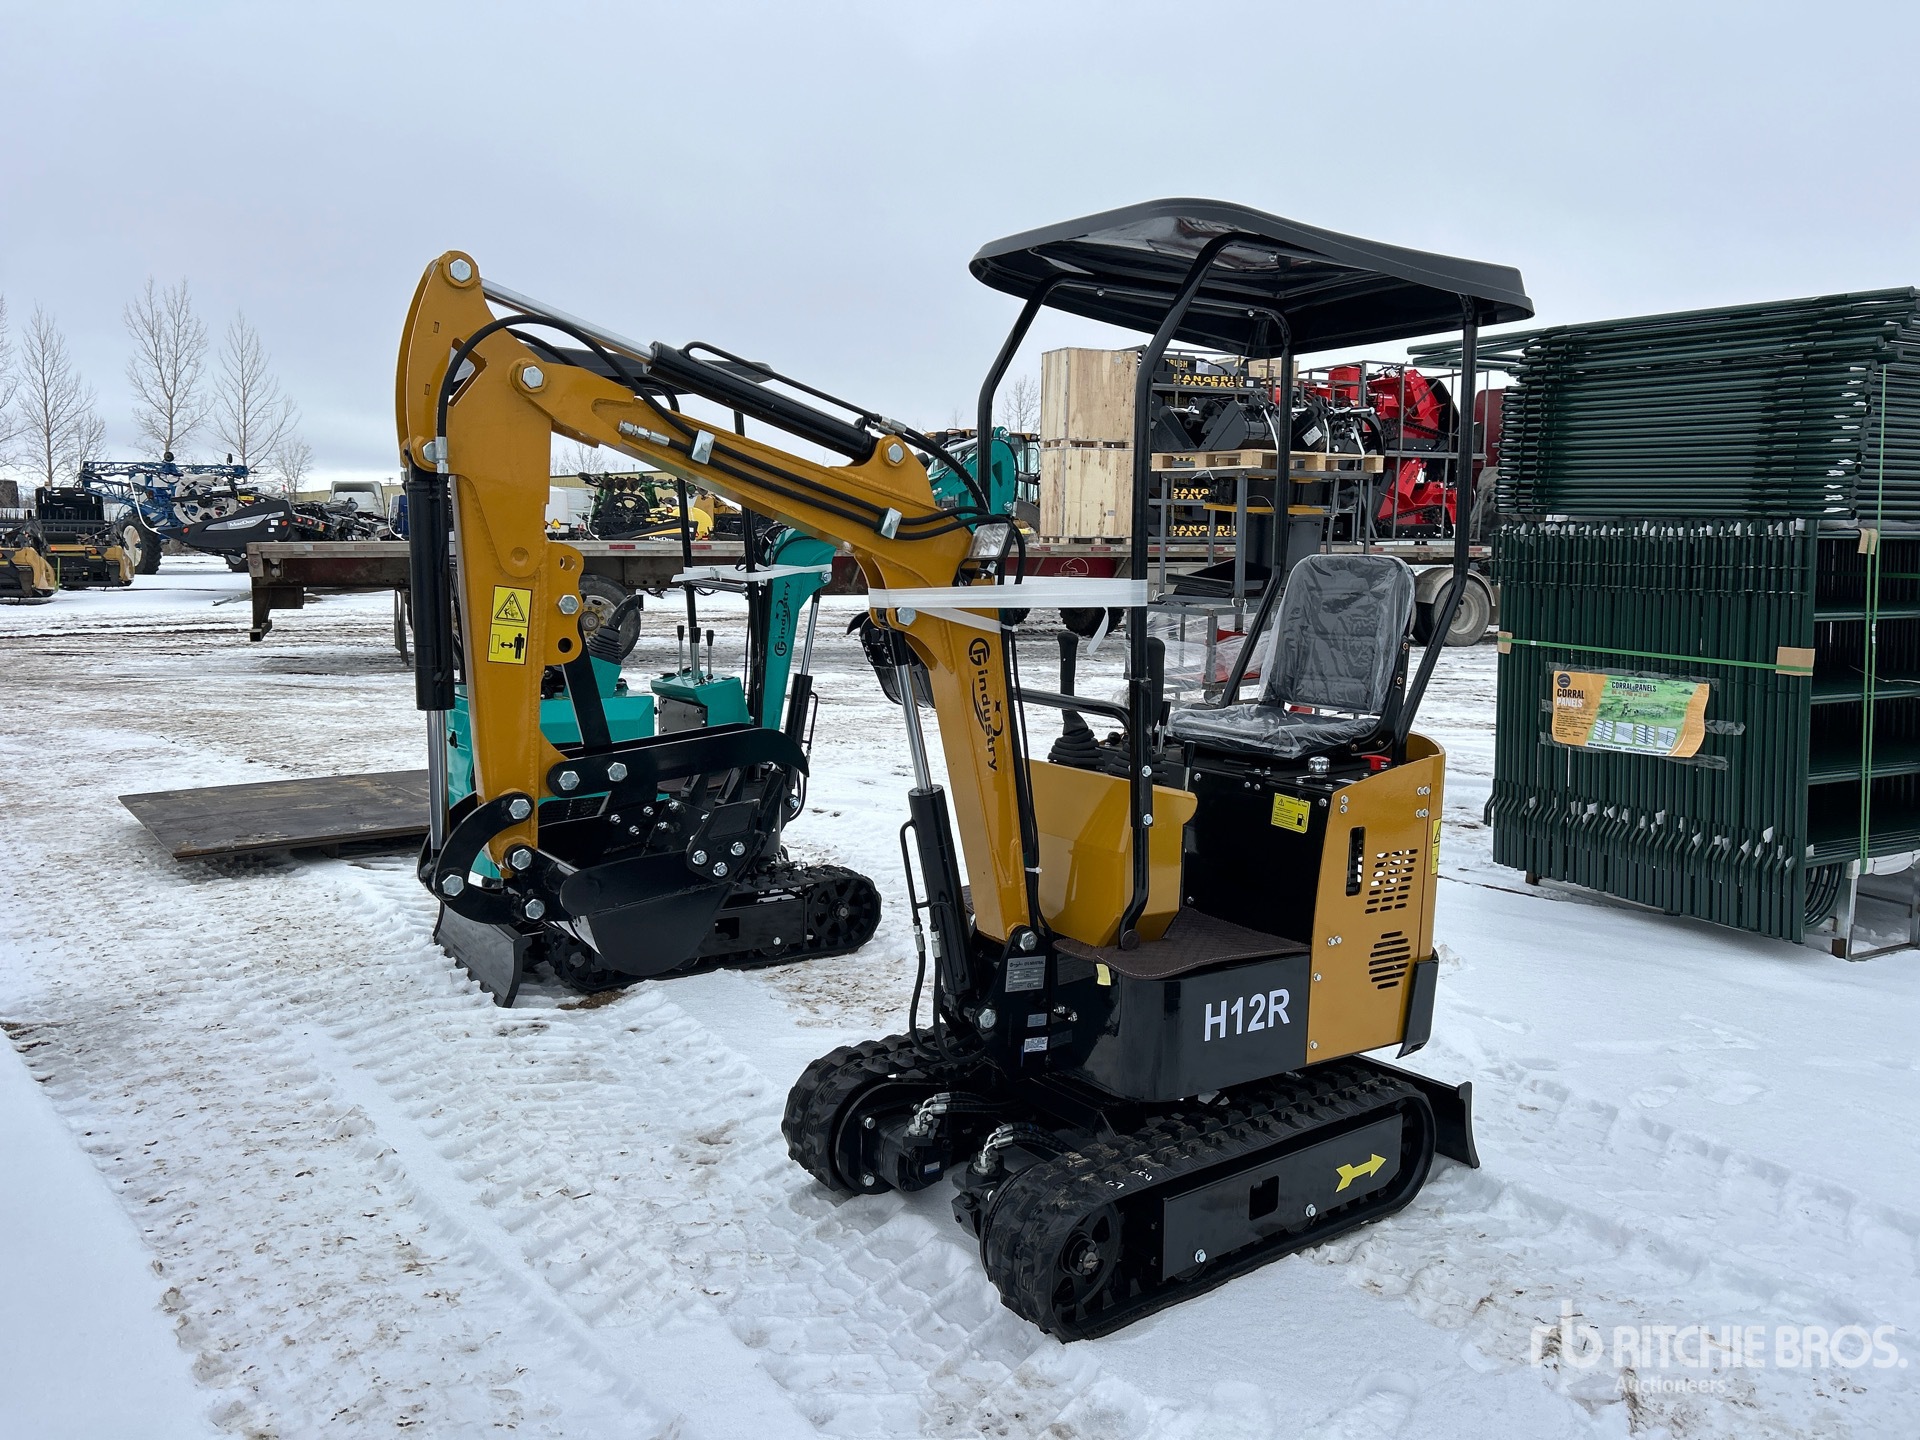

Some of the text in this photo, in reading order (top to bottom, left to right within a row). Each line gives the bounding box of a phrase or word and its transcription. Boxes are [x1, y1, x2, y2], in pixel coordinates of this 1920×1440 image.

[1611, 682, 1656, 692] CORRAL PANELS
[1557, 688, 1584, 699] CORRAL
[1556, 698, 1582, 708] PANELS
[1204, 988, 1290, 1041] H12R
